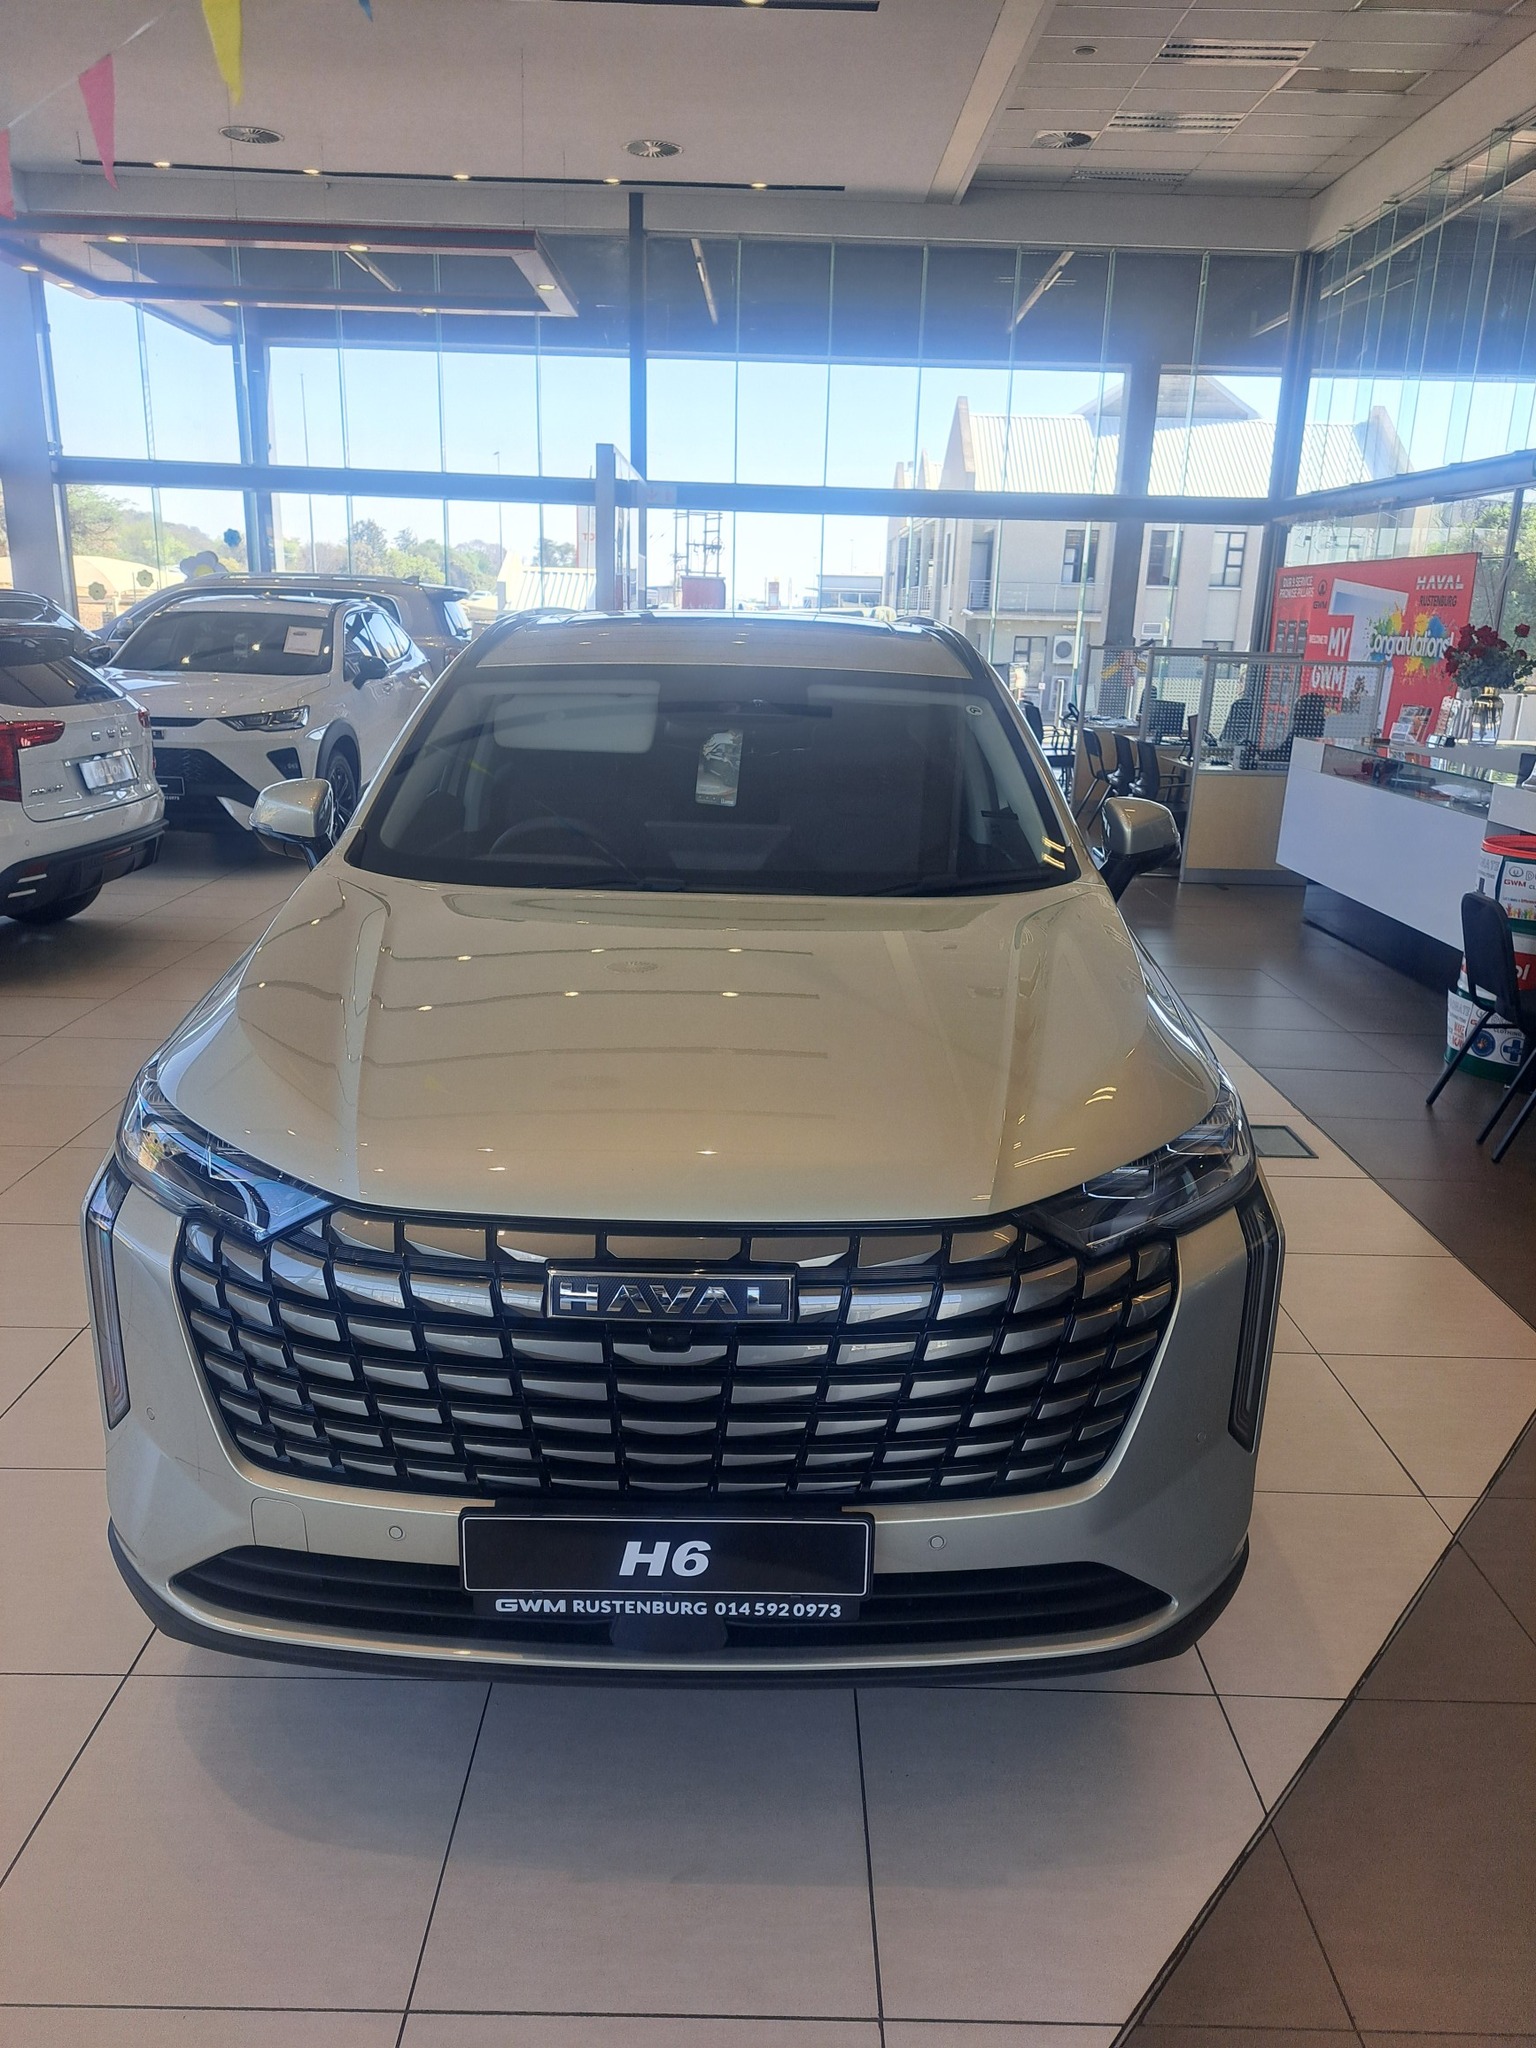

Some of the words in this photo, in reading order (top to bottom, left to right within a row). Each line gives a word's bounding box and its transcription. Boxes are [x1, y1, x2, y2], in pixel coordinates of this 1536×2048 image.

[1416, 575, 1465, 590] HAVAL
[1419, 595, 1457, 607] RUSTENBURG
[1327, 627, 1351, 657] MY
[1311, 664, 1346, 691] GWM
[1504, 879, 1527, 888] GWM
[559, 1282, 782, 1315] HAVAL
[619, 1540, 712, 1578] H6
[495, 1598, 566, 1613] GWM
[572, 1599, 708, 1615] RUSTENBURG
